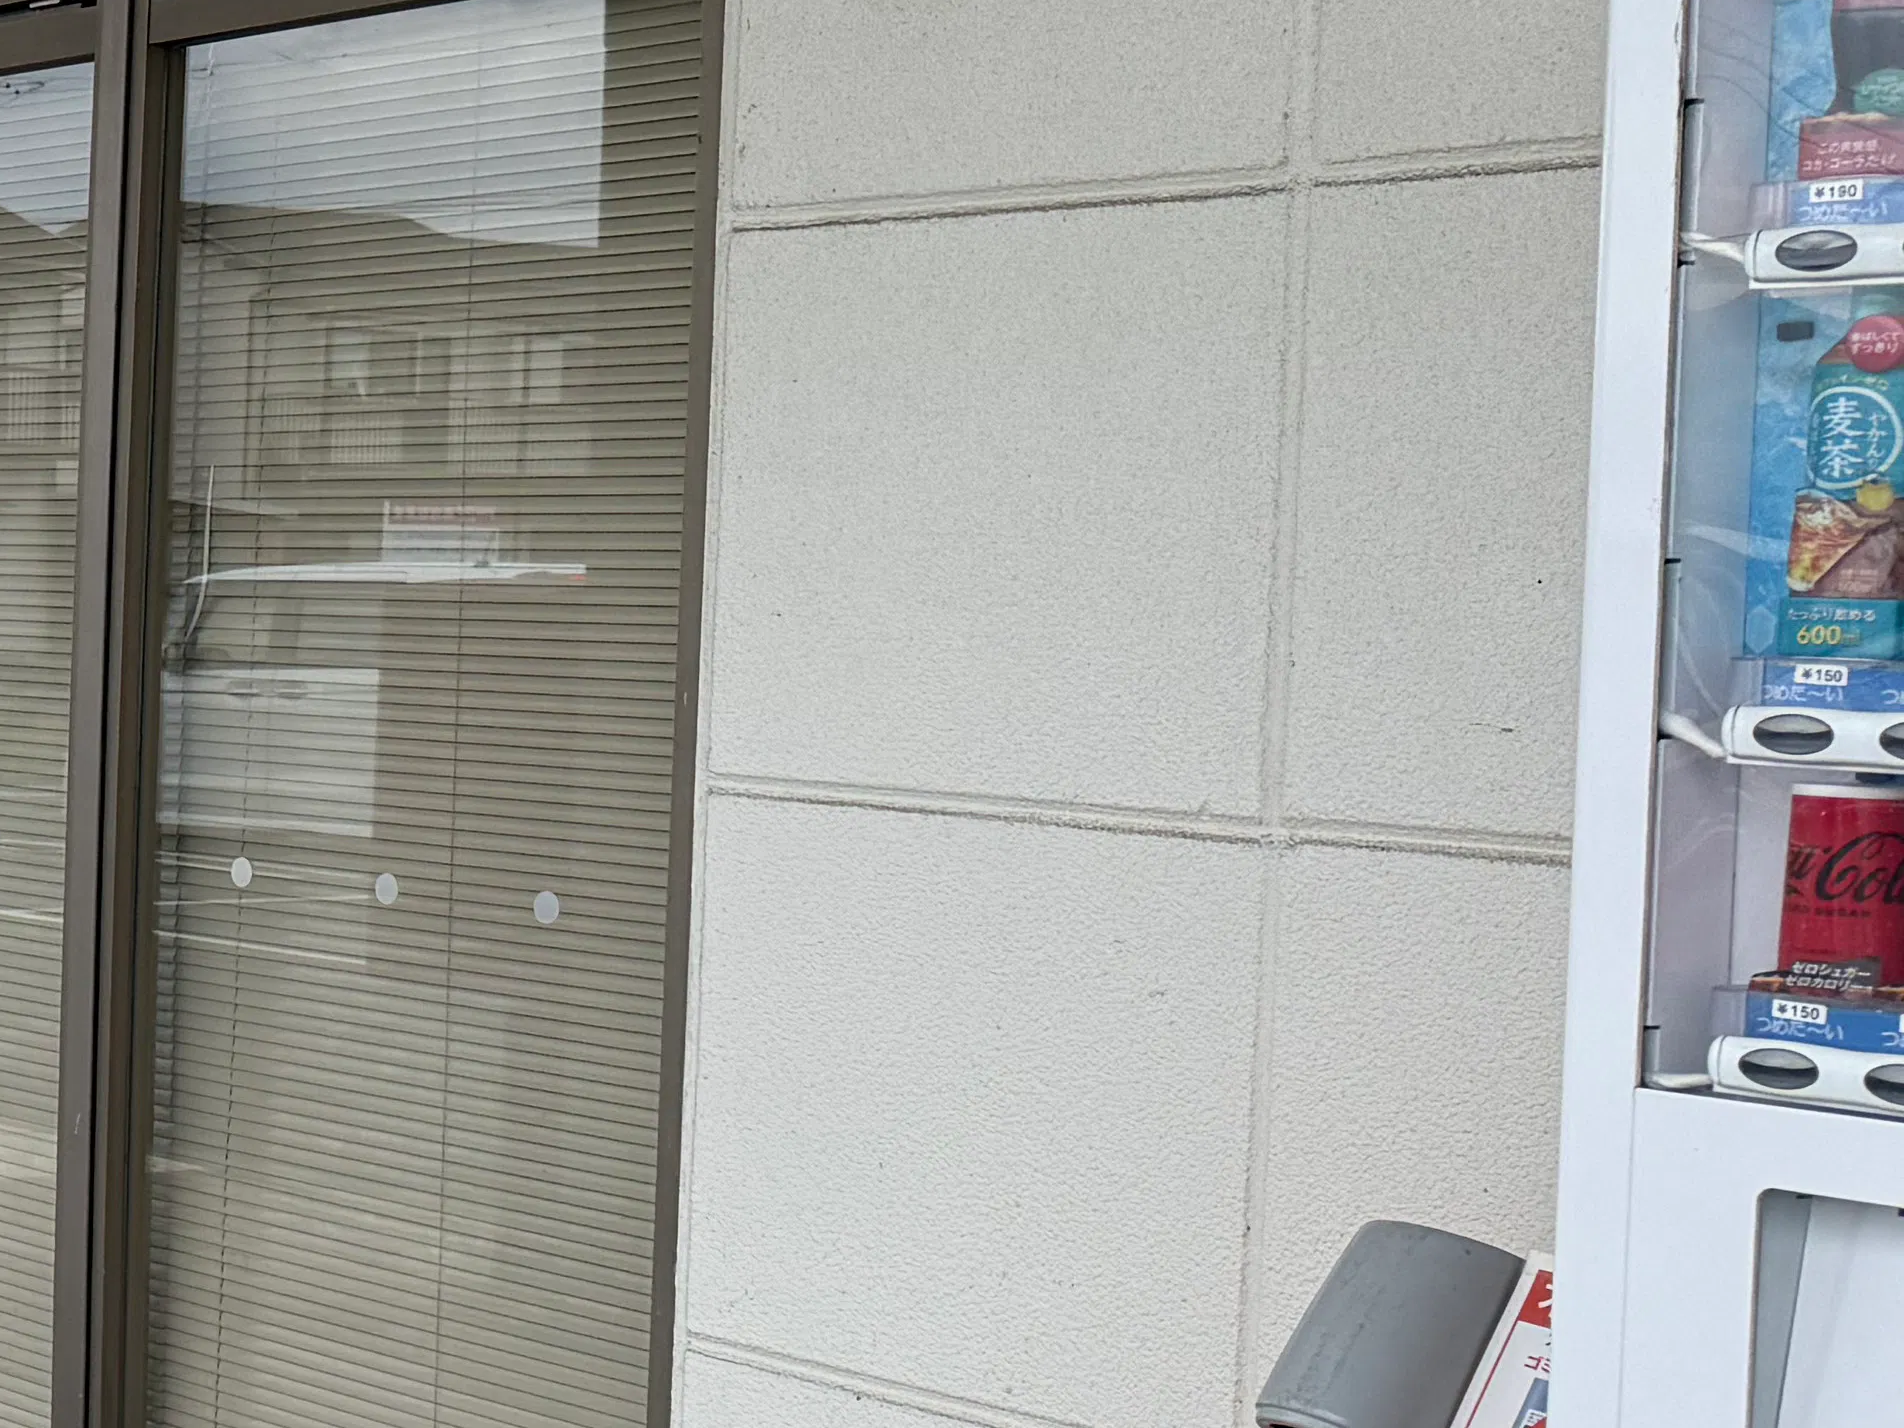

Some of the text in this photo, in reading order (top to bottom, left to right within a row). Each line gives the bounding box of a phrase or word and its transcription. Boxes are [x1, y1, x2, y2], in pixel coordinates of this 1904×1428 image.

[1819, 397, 1865, 478] 麦茶
[1792, 961, 1871, 979] ゼロシュガー
[1785, 974, 1874, 992] ゼロカロリー
